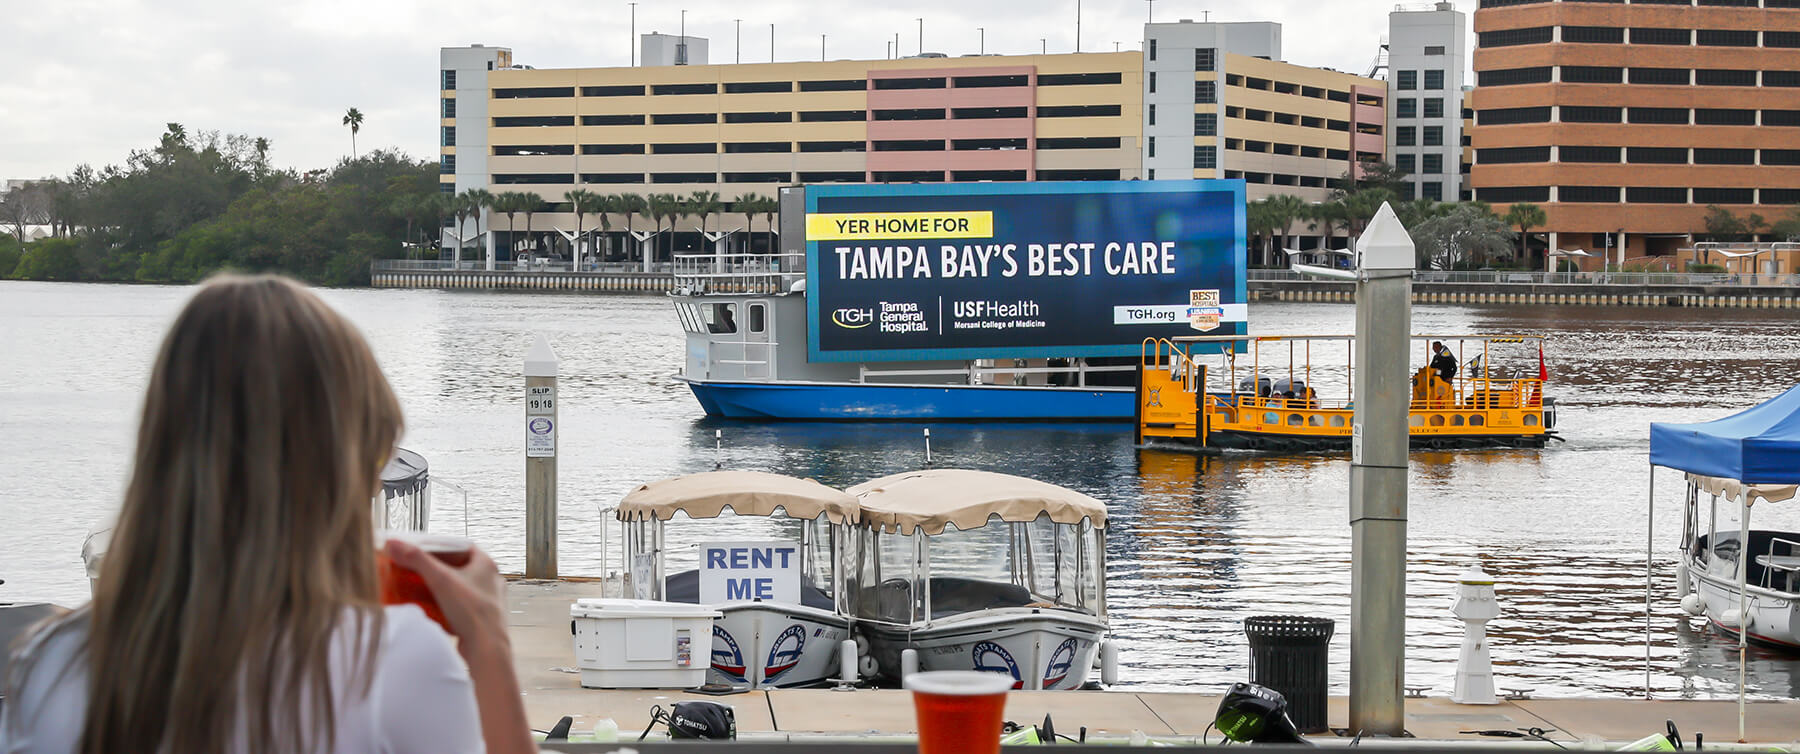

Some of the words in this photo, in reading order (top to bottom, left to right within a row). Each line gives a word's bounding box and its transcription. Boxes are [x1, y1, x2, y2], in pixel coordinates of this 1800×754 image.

[836, 219, 870, 234] YER
[875, 218, 929, 234] HOME
[934, 217, 969, 233] FOR
[835, 246, 932, 280] TAMPA
[941, 243, 1018, 279] BAY'S
[1028, 242, 1096, 277] BEST
[1104, 240, 1176, 276] CARE
[1191, 291, 1218, 301] BEST
[879, 301, 918, 315] Tampa
[839, 308, 873, 323] TGH
[880, 311, 924, 322] General
[1127, 309, 1176, 322] TGH.org
[954, 320, 981, 329] Morsani
[981, 320, 1006, 331] College
[1007, 320, 1014, 328] of
[1015, 319, 1046, 328] Medicine
[530, 400, 539, 408] 19
[543, 400, 552, 408] 18
[707, 548, 796, 569] RENT
[727, 578, 774, 601] ME
[988, 643, 1015, 668] TAMPA
[683, 719, 708, 731] TOHATSU
